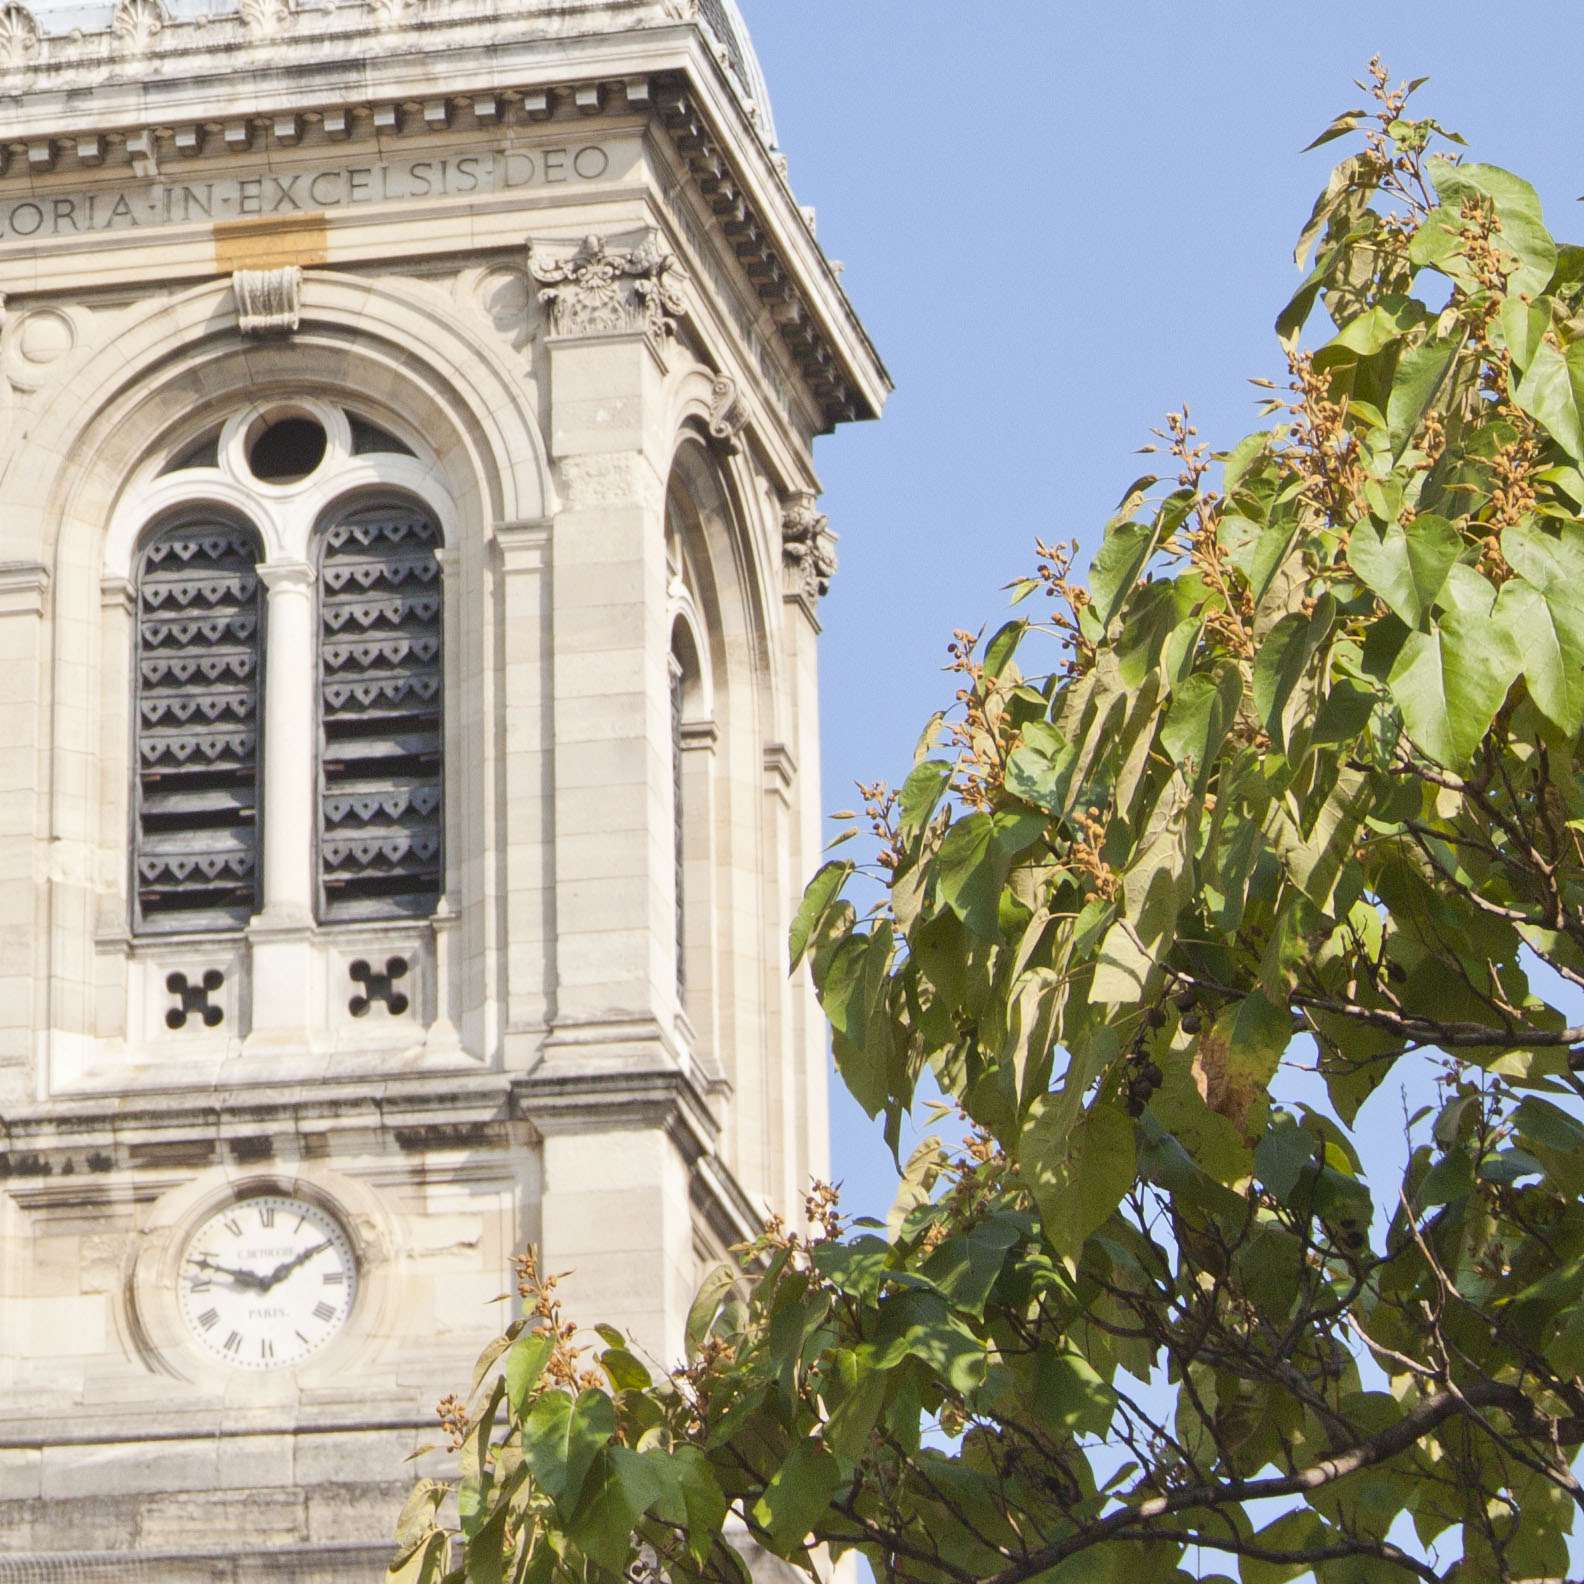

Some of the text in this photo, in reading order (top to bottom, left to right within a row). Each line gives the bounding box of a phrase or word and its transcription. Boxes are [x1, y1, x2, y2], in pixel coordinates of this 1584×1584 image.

[162, 182, 215, 225] IN
[237, 156, 481, 215] EXCELSIS
[493, 144, 610, 189] DEO
